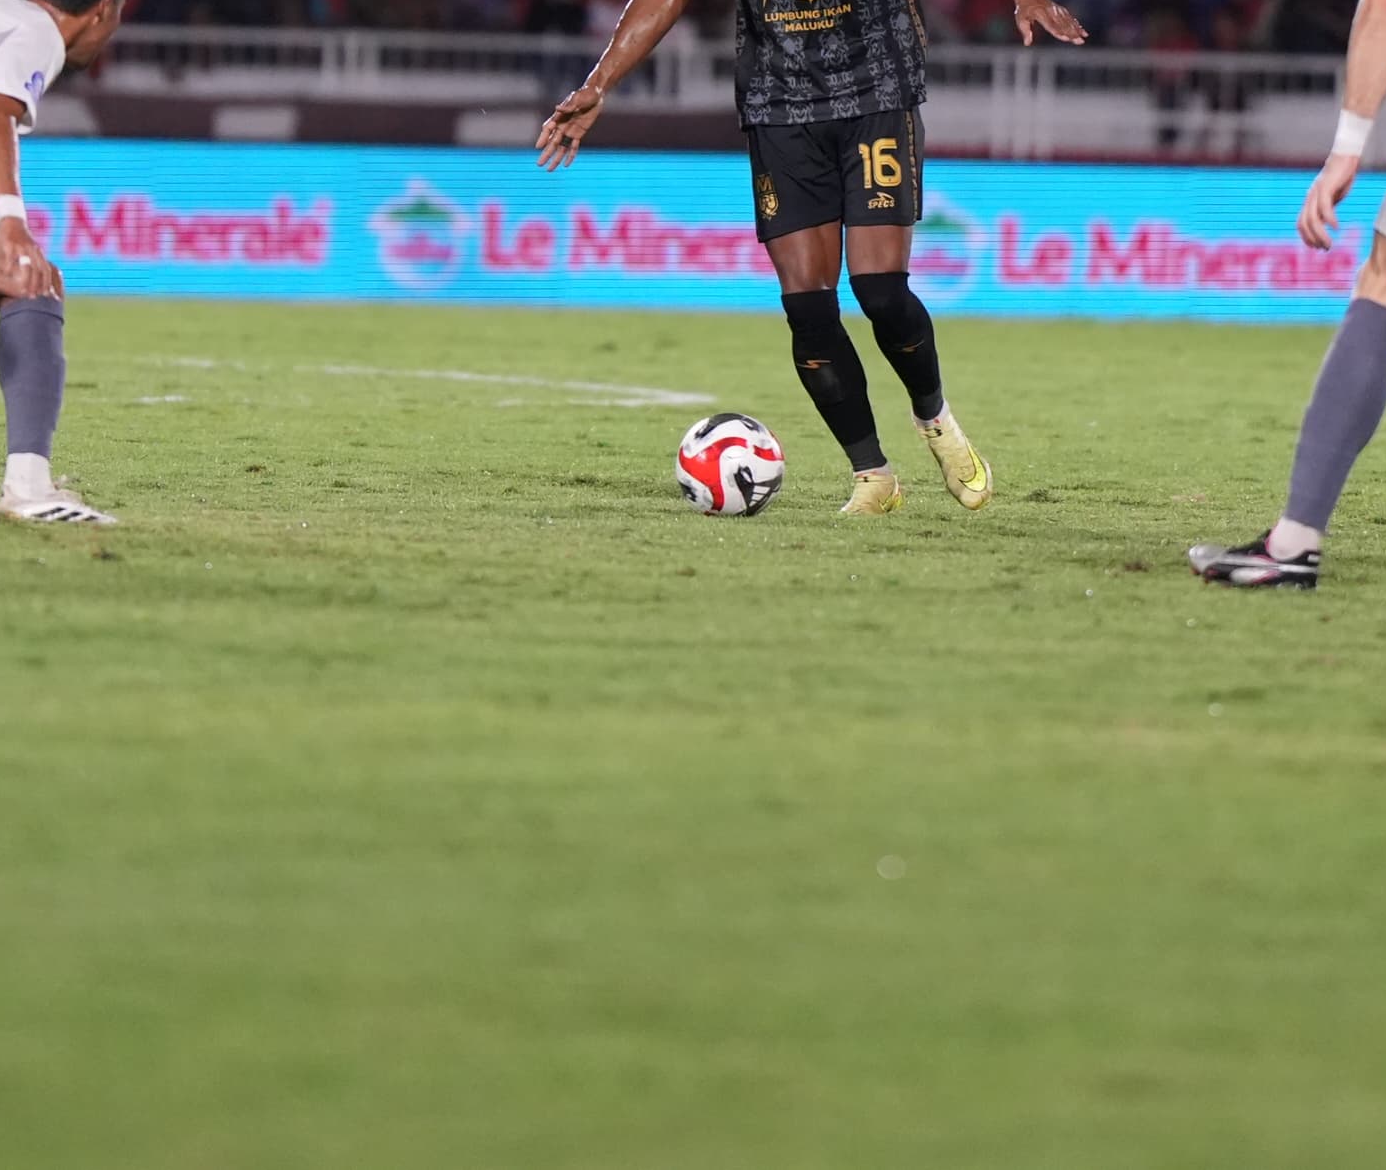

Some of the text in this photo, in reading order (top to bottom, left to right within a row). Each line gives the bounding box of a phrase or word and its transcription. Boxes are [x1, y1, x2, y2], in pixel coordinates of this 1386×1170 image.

[764, 4, 852, 22] LUMBUNG IKAN
[784, 19, 835, 32] MALUKU
[858, 138, 902, 189] 16
[482, 200, 554, 270] Le
[998, 215, 1070, 285] Le
